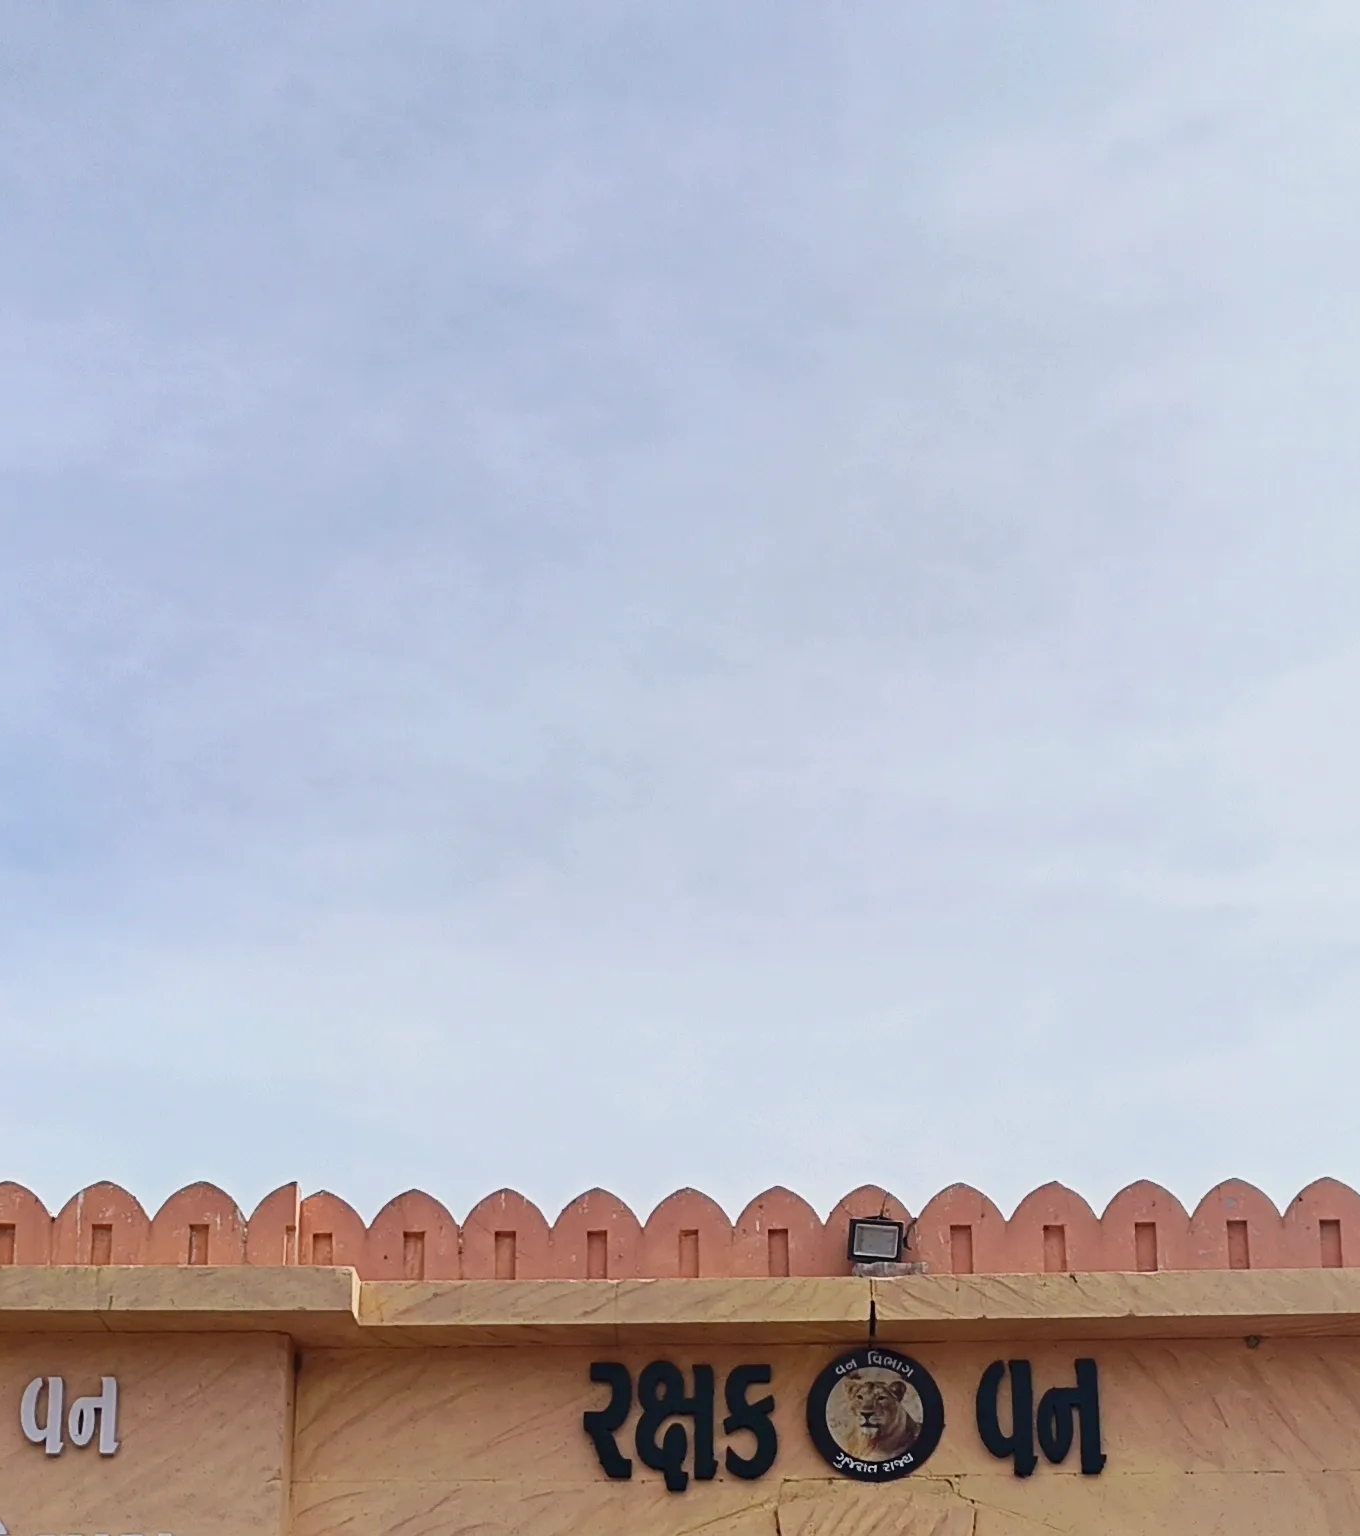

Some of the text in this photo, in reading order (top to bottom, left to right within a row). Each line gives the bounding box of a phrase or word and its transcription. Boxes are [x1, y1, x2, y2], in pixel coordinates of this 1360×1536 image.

[835, 1350, 915, 1378] વન વિભાગ
[20, 1376, 120, 1456] વન
[583, 1358, 1107, 1492] રક્ષક વન
[832, 1452, 878, 1473] ગુજરાત
